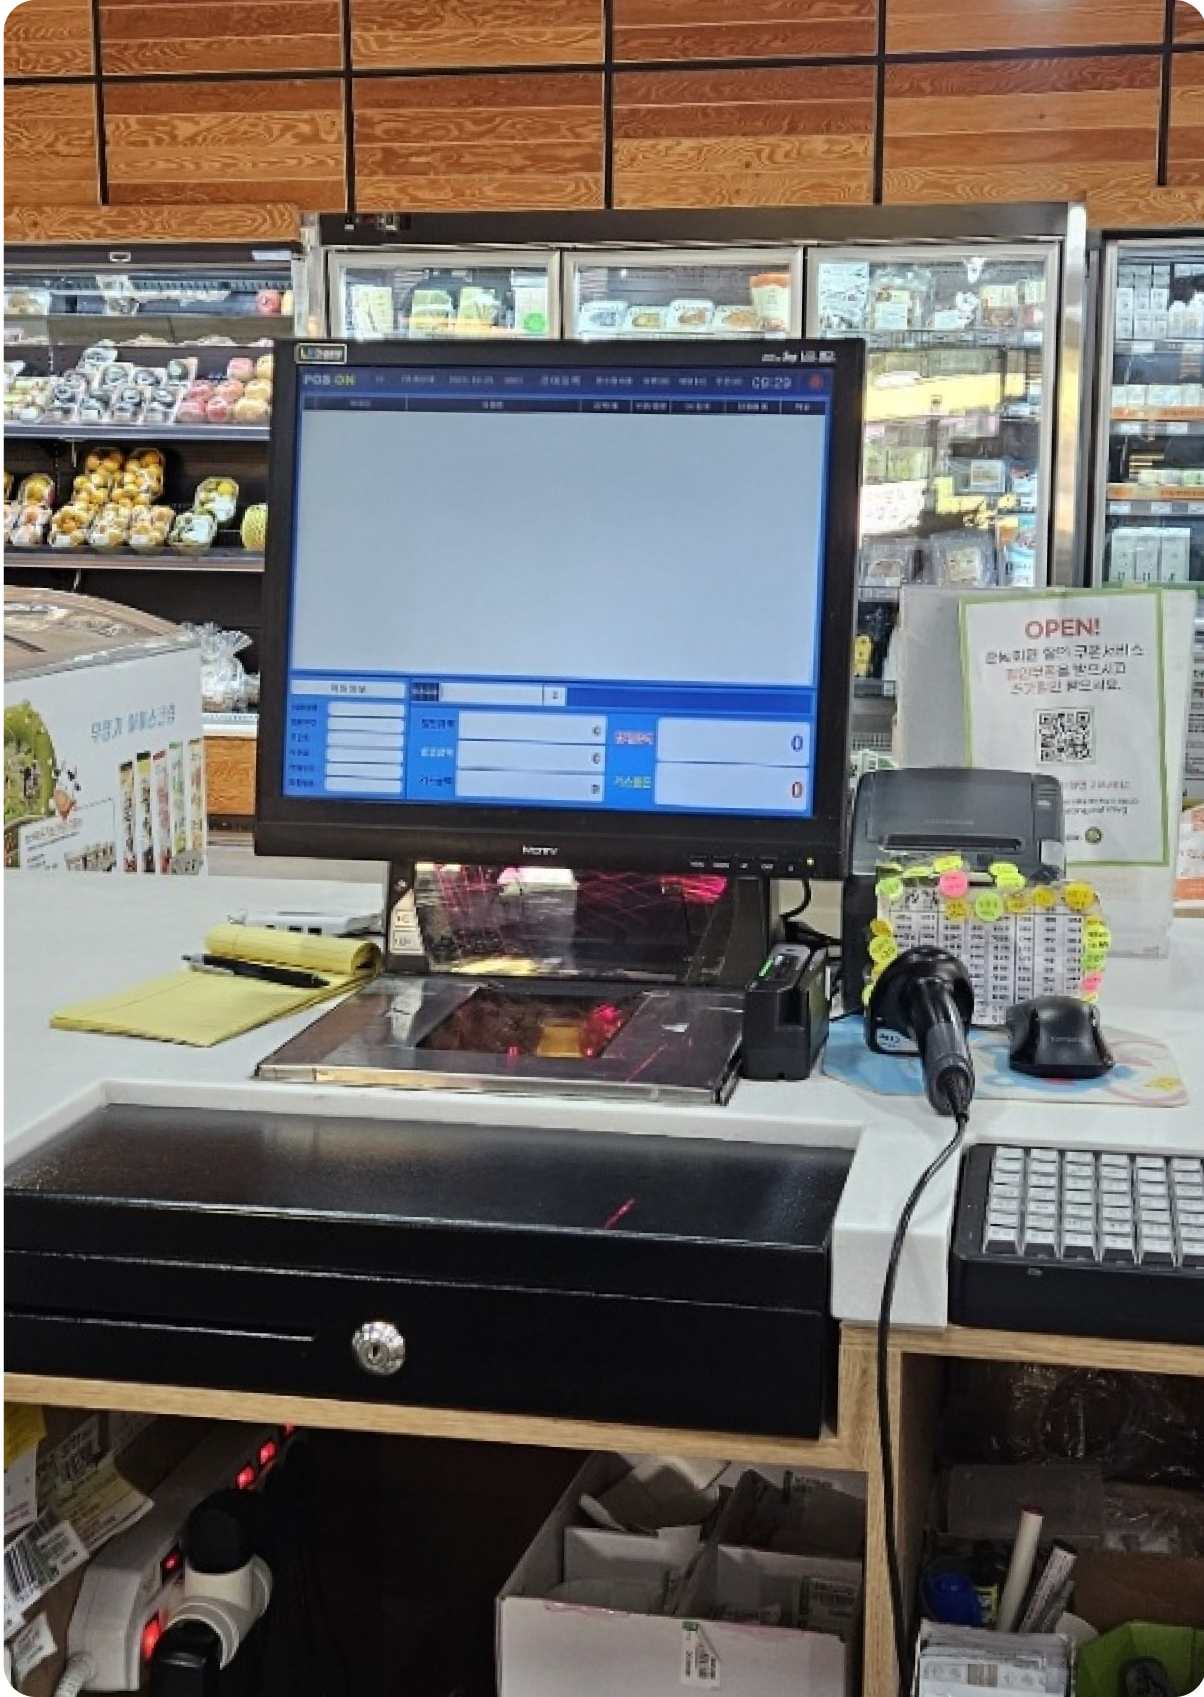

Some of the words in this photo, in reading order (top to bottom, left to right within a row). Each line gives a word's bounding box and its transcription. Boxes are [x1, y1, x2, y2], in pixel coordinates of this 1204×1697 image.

[303, 373, 331, 386] POS
[334, 373, 356, 386] ON
[1025, 617, 1100, 639] OPEN!
[790, 734, 803, 752] 0
[791, 781, 803, 799] 0
